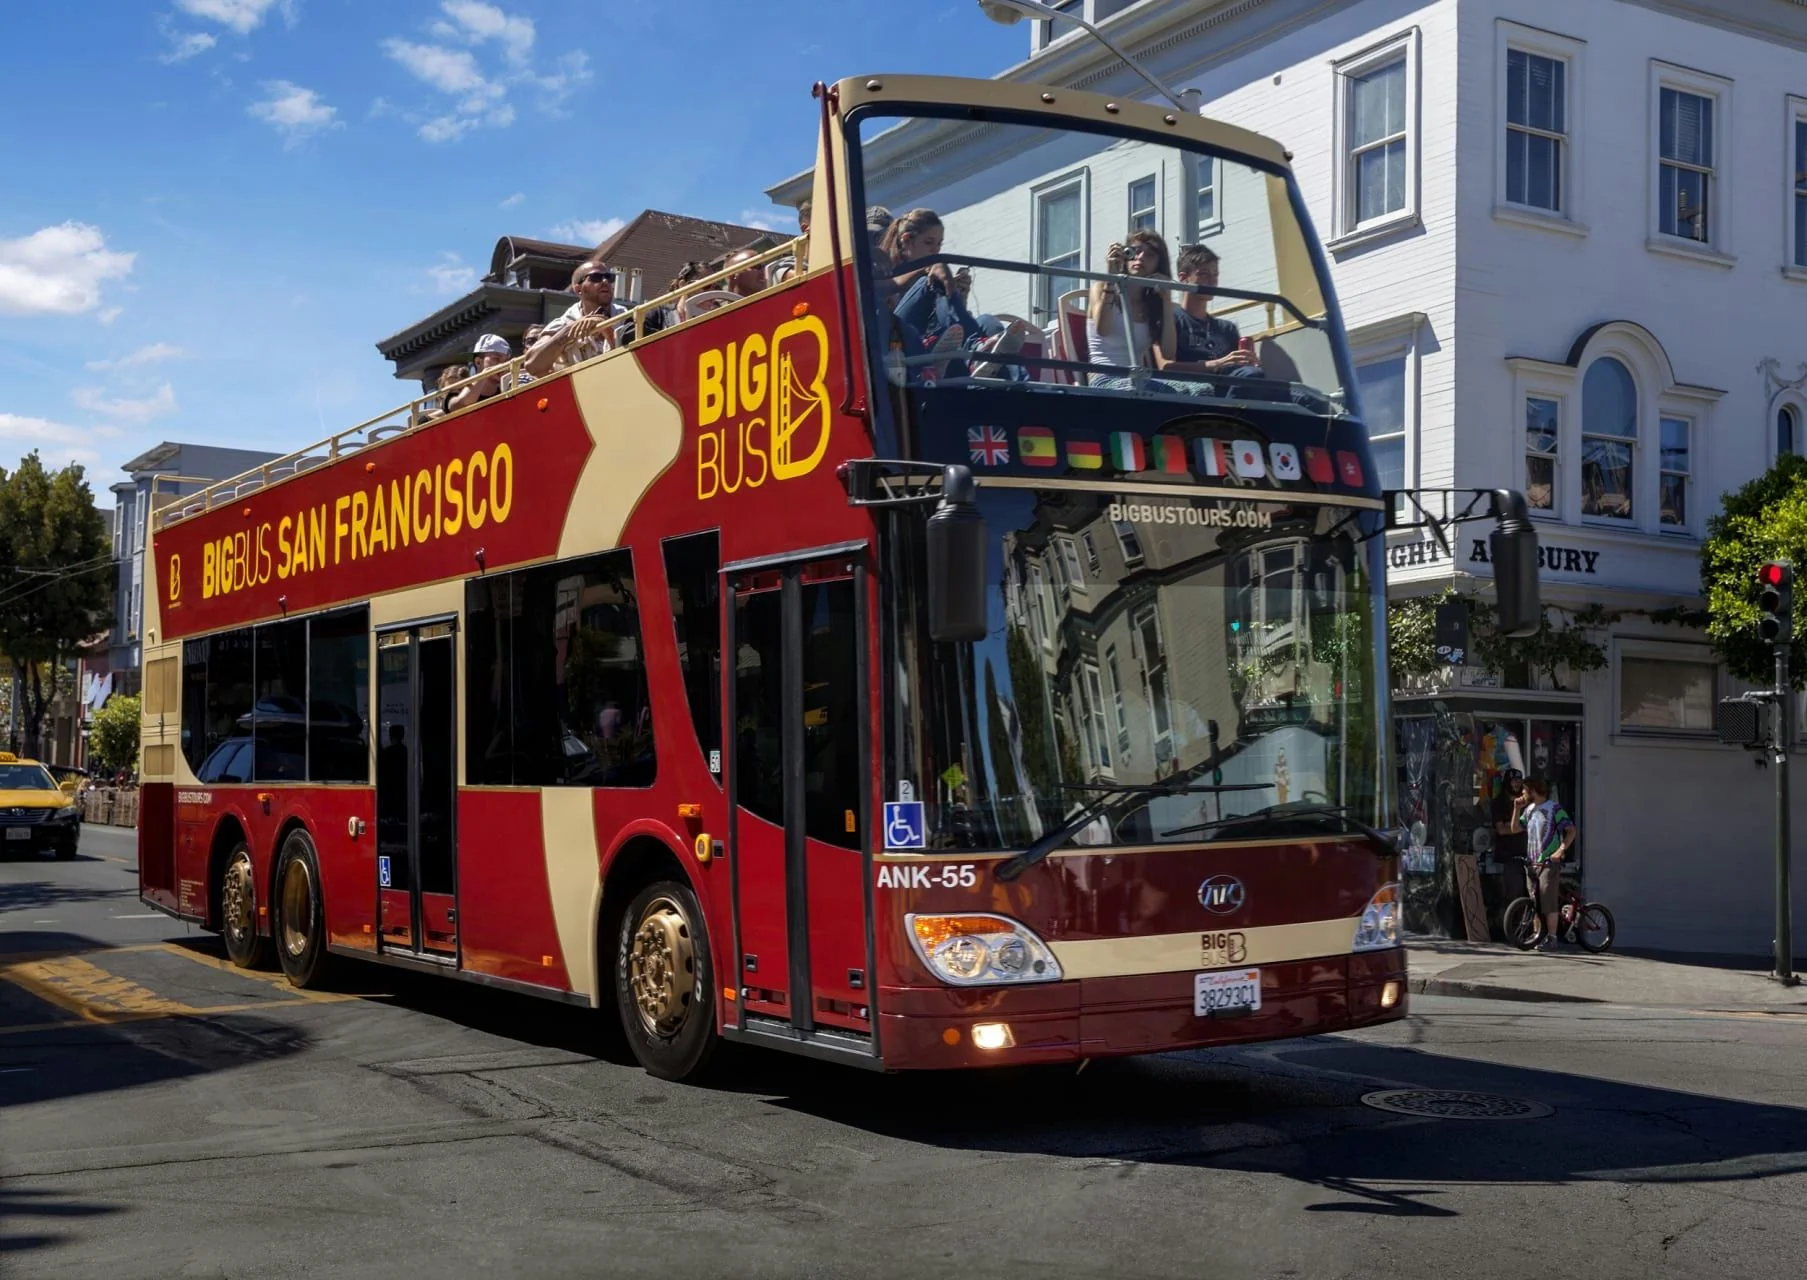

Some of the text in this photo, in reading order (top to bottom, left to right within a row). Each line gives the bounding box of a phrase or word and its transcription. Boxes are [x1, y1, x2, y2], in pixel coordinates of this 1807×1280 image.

[699, 333, 768, 426] BIG
[698, 417, 768, 500] BUS
[202, 442, 513, 599] BIGBUS SAN FRANCISCO
[1109, 503, 1272, 528] BIGBUSTOURS.COM
[1469, 539, 1600, 573] ABURY
[877, 864, 977, 889] ANK-55
[1202, 933, 1227, 950] BIG
[1202, 949, 1227, 967] BUS
[1200, 984, 1257, 1010] 38293C1
